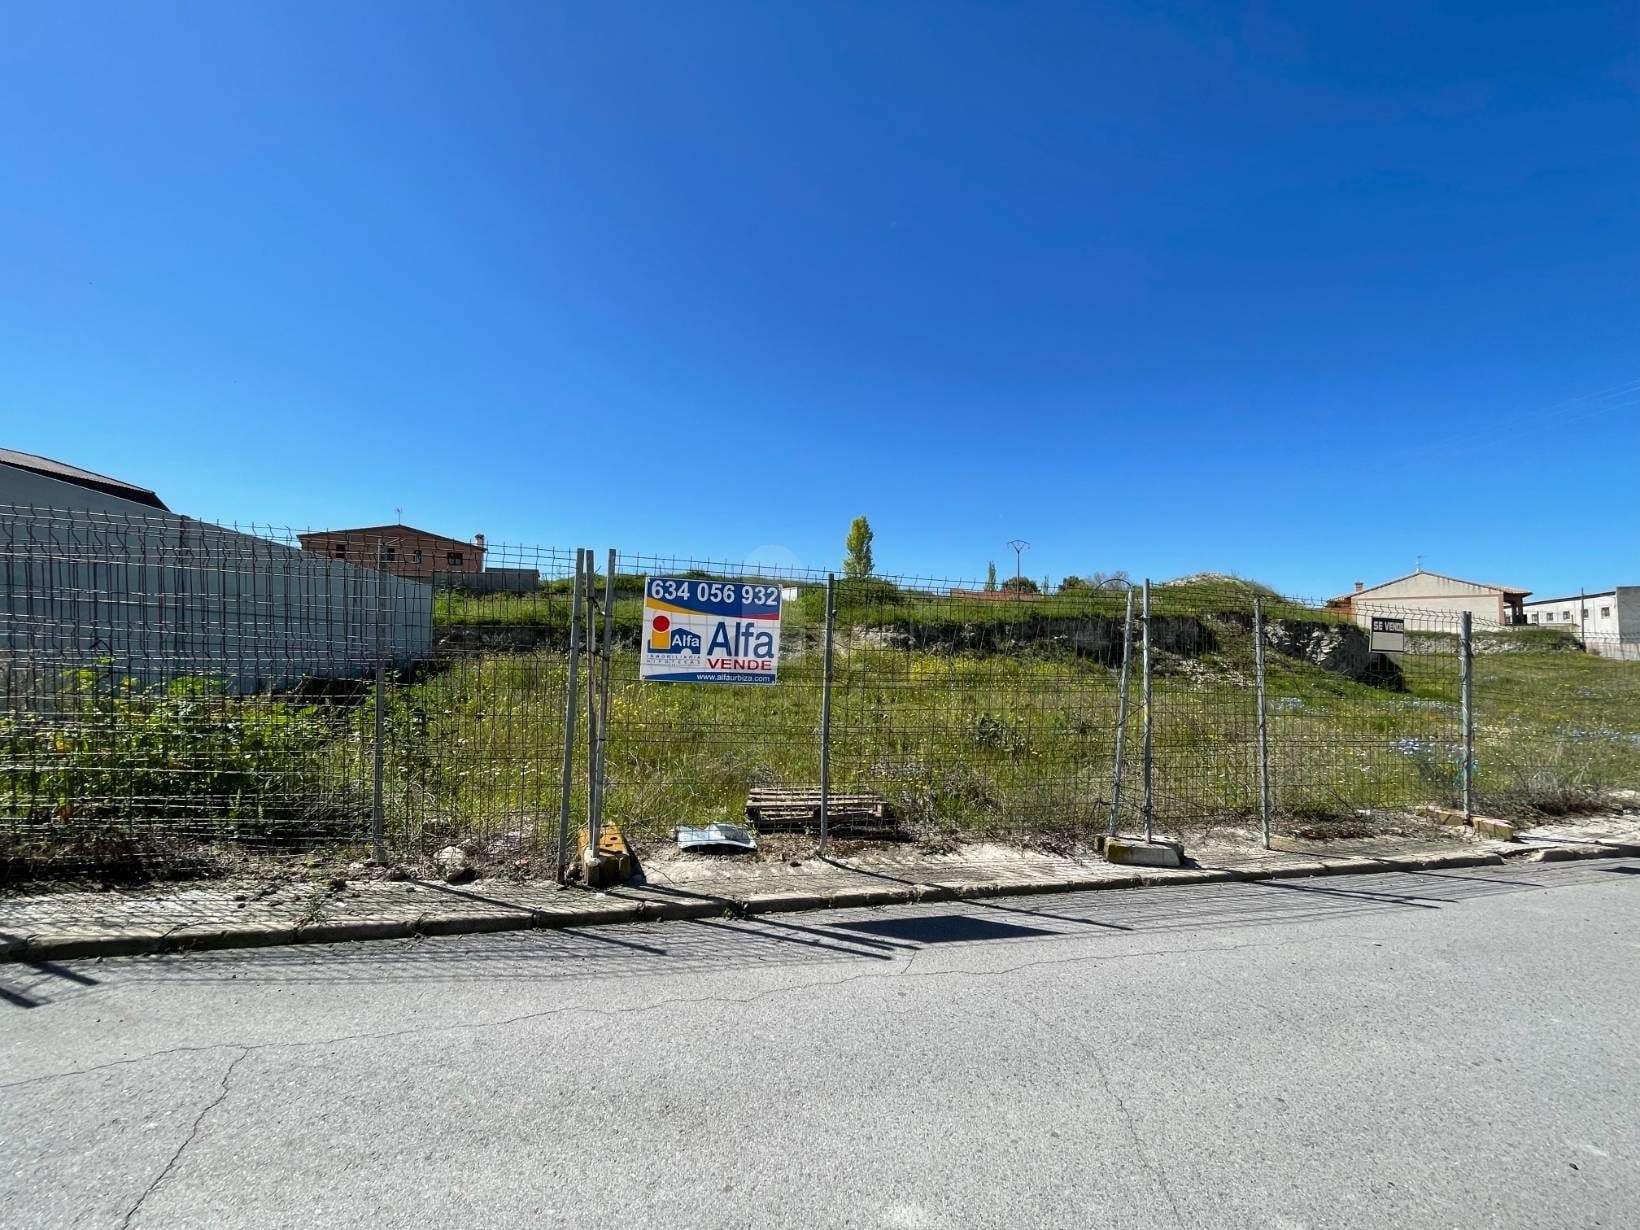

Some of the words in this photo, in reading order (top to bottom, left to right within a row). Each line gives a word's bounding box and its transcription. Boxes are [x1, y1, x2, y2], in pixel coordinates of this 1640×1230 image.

[651, 580, 690, 601] 634
[697, 583, 735, 603] 056
[741, 586, 778, 606] 932
[1373, 620, 1383, 630] SE
[1384, 621, 1404, 632] VENDE
[672, 634, 700, 647] Alfa
[707, 621, 775, 659] Alfa
[707, 658, 772, 671] VENDE
[696, 673, 770, 683] www.alfaurbiza.com
